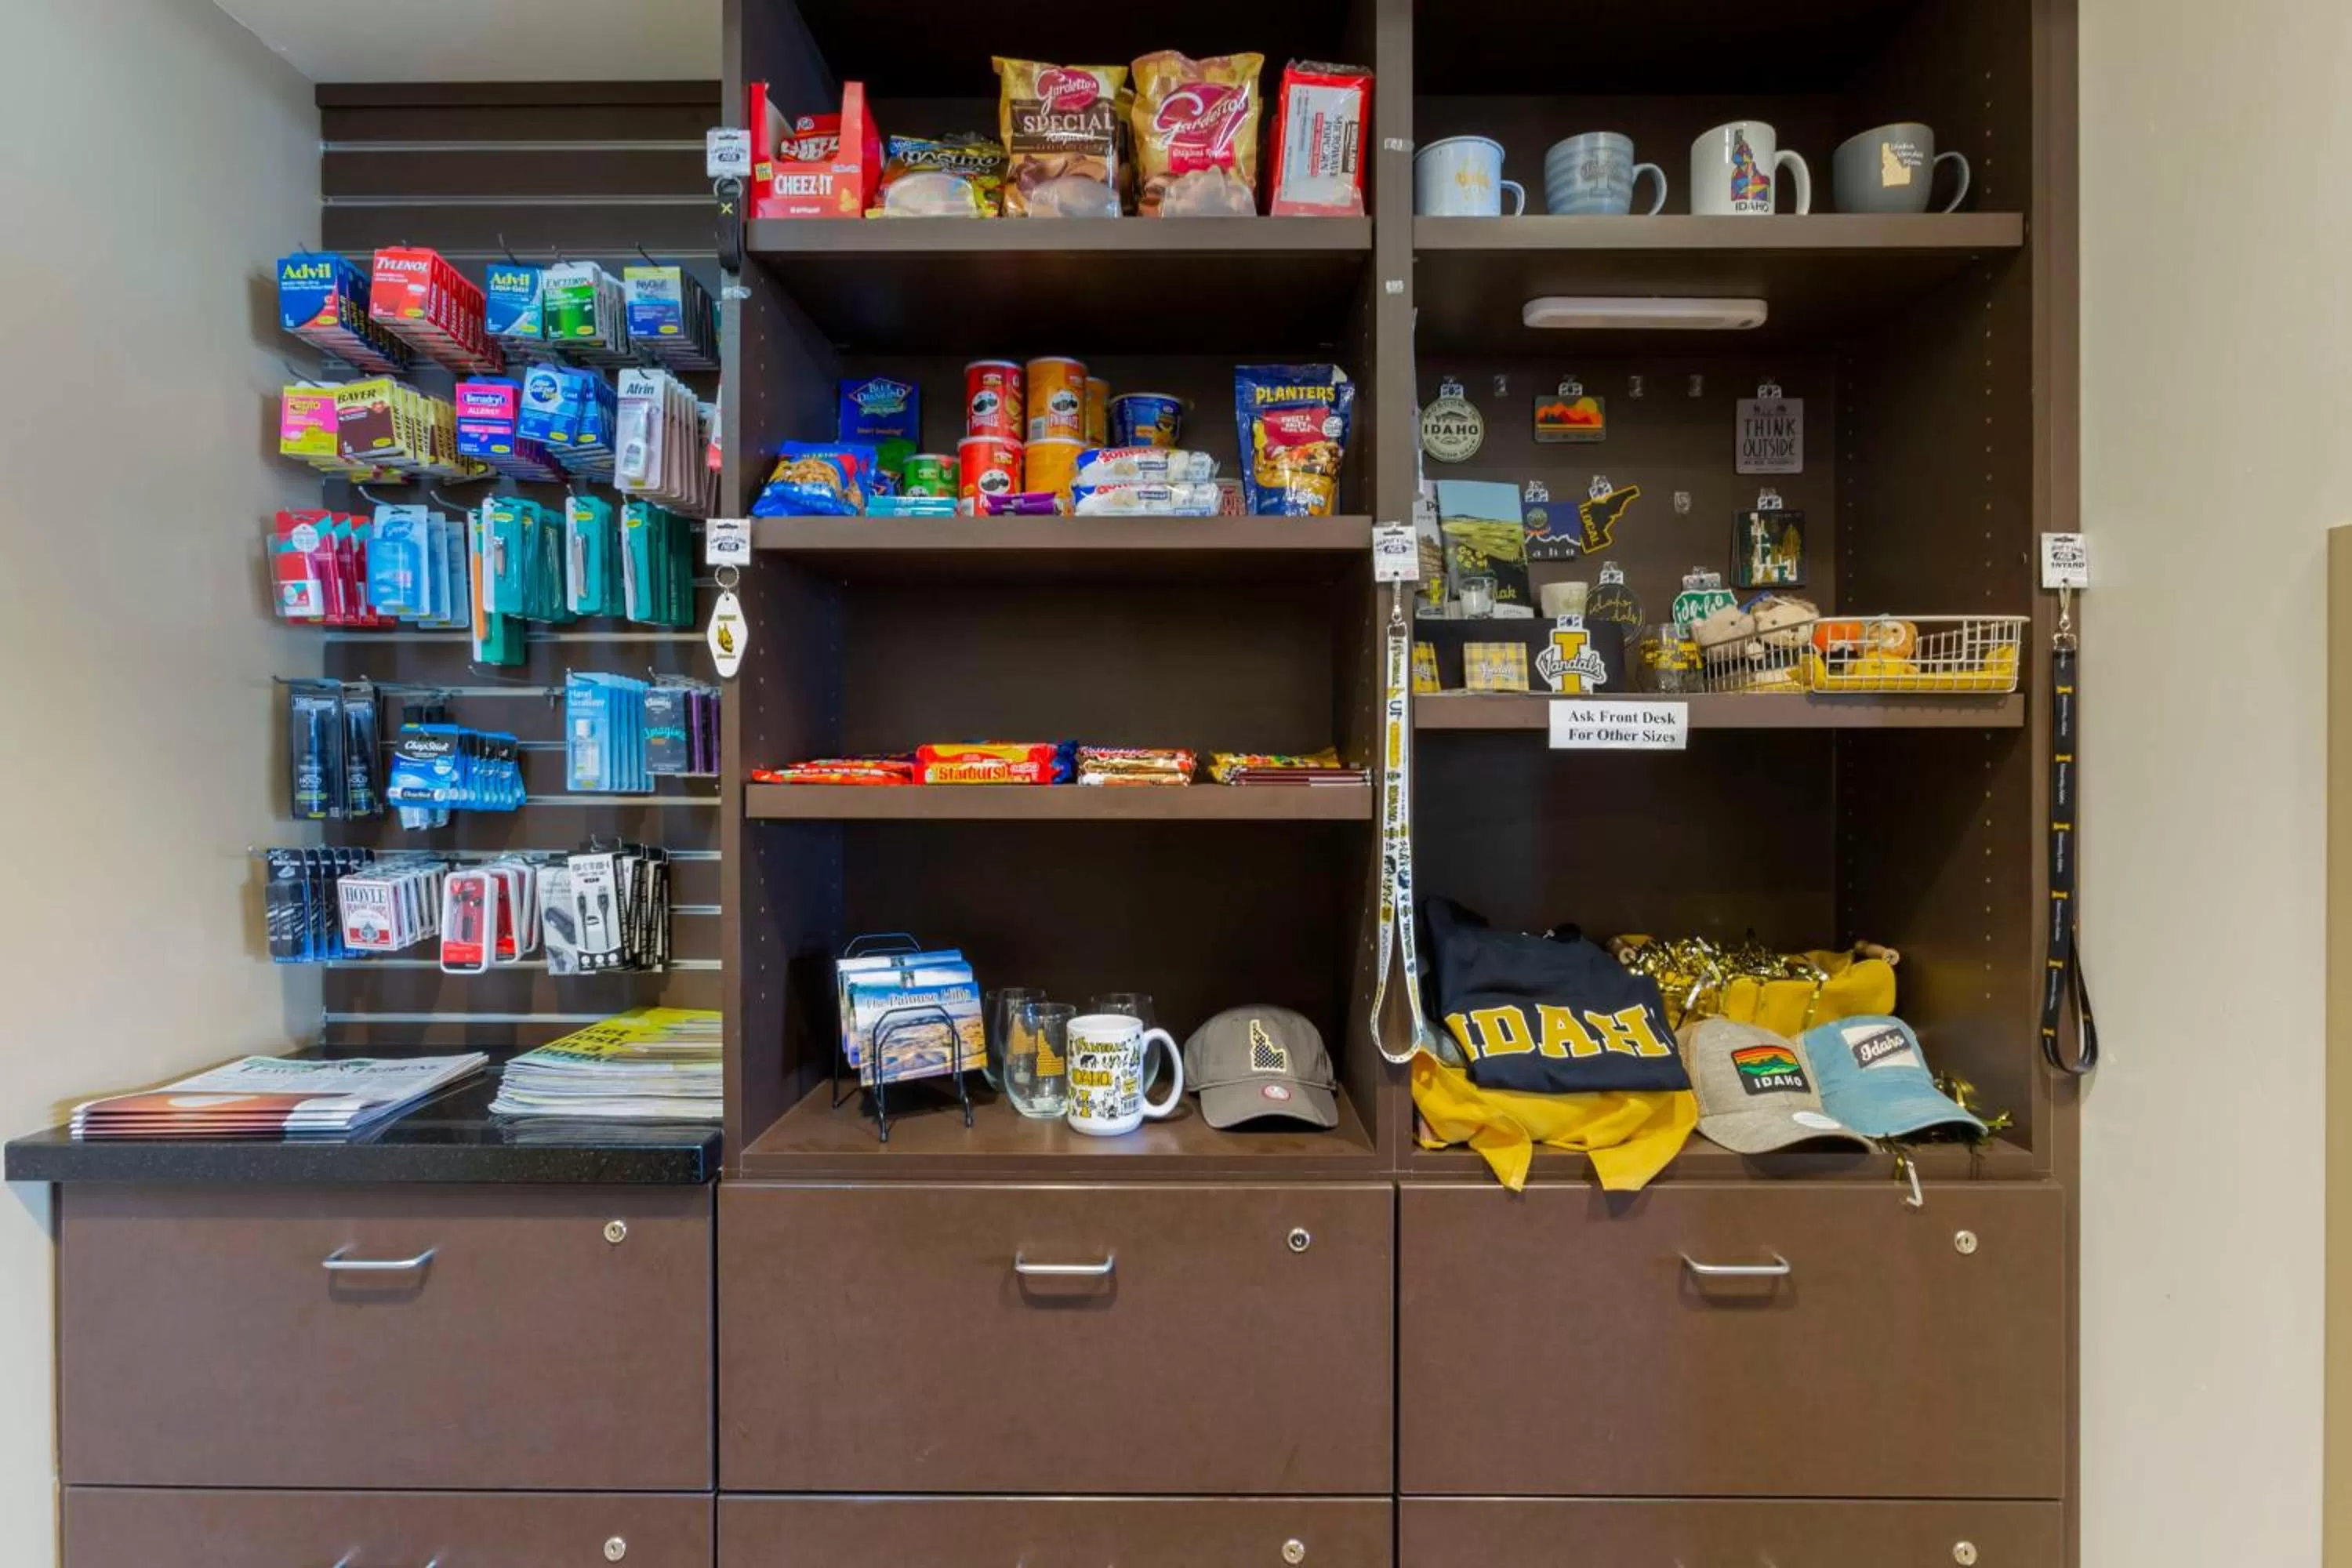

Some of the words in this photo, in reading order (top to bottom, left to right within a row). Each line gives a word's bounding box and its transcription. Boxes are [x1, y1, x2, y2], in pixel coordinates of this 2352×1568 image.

[1023, 111, 1115, 132] SPECIAL
[1735, 201, 1769, 212] IDAHO
[283, 263, 332, 279] Advil
[376, 256, 427, 271] TYLENOL
[491, 272, 531, 285] Advil
[338, 389, 377, 403] BAYER
[626, 383, 655, 394] Afrin
[1255, 386, 1336, 405] PLANTERS
[1424, 424, 1479, 435] IDAHO
[1743, 417, 1795, 437] THINK
[1743, 438, 1795, 458] OUTSIDE
[1539, 649, 1605, 681] Vandals
[568, 689, 592, 699] Hand
[1568, 710, 1595, 723] Ask
[1600, 710, 1638, 724] Front
[1642, 710, 1676, 725] Desk
[1568, 728, 1594, 742] For
[1597, 728, 1639, 742] Other
[1642, 729, 1676, 743] Sizes
[405, 740, 449, 752] ChapStick
[938, 766, 1008, 782] Starburst
[345, 886, 385, 903] HOYLE
[890, 993, 935, 1007] Palouse
[1444, 1004, 1674, 1062] IDAH
[1860, 1034, 1905, 1061] Idaho
[1753, 1076, 1803, 1089] IDAHO
